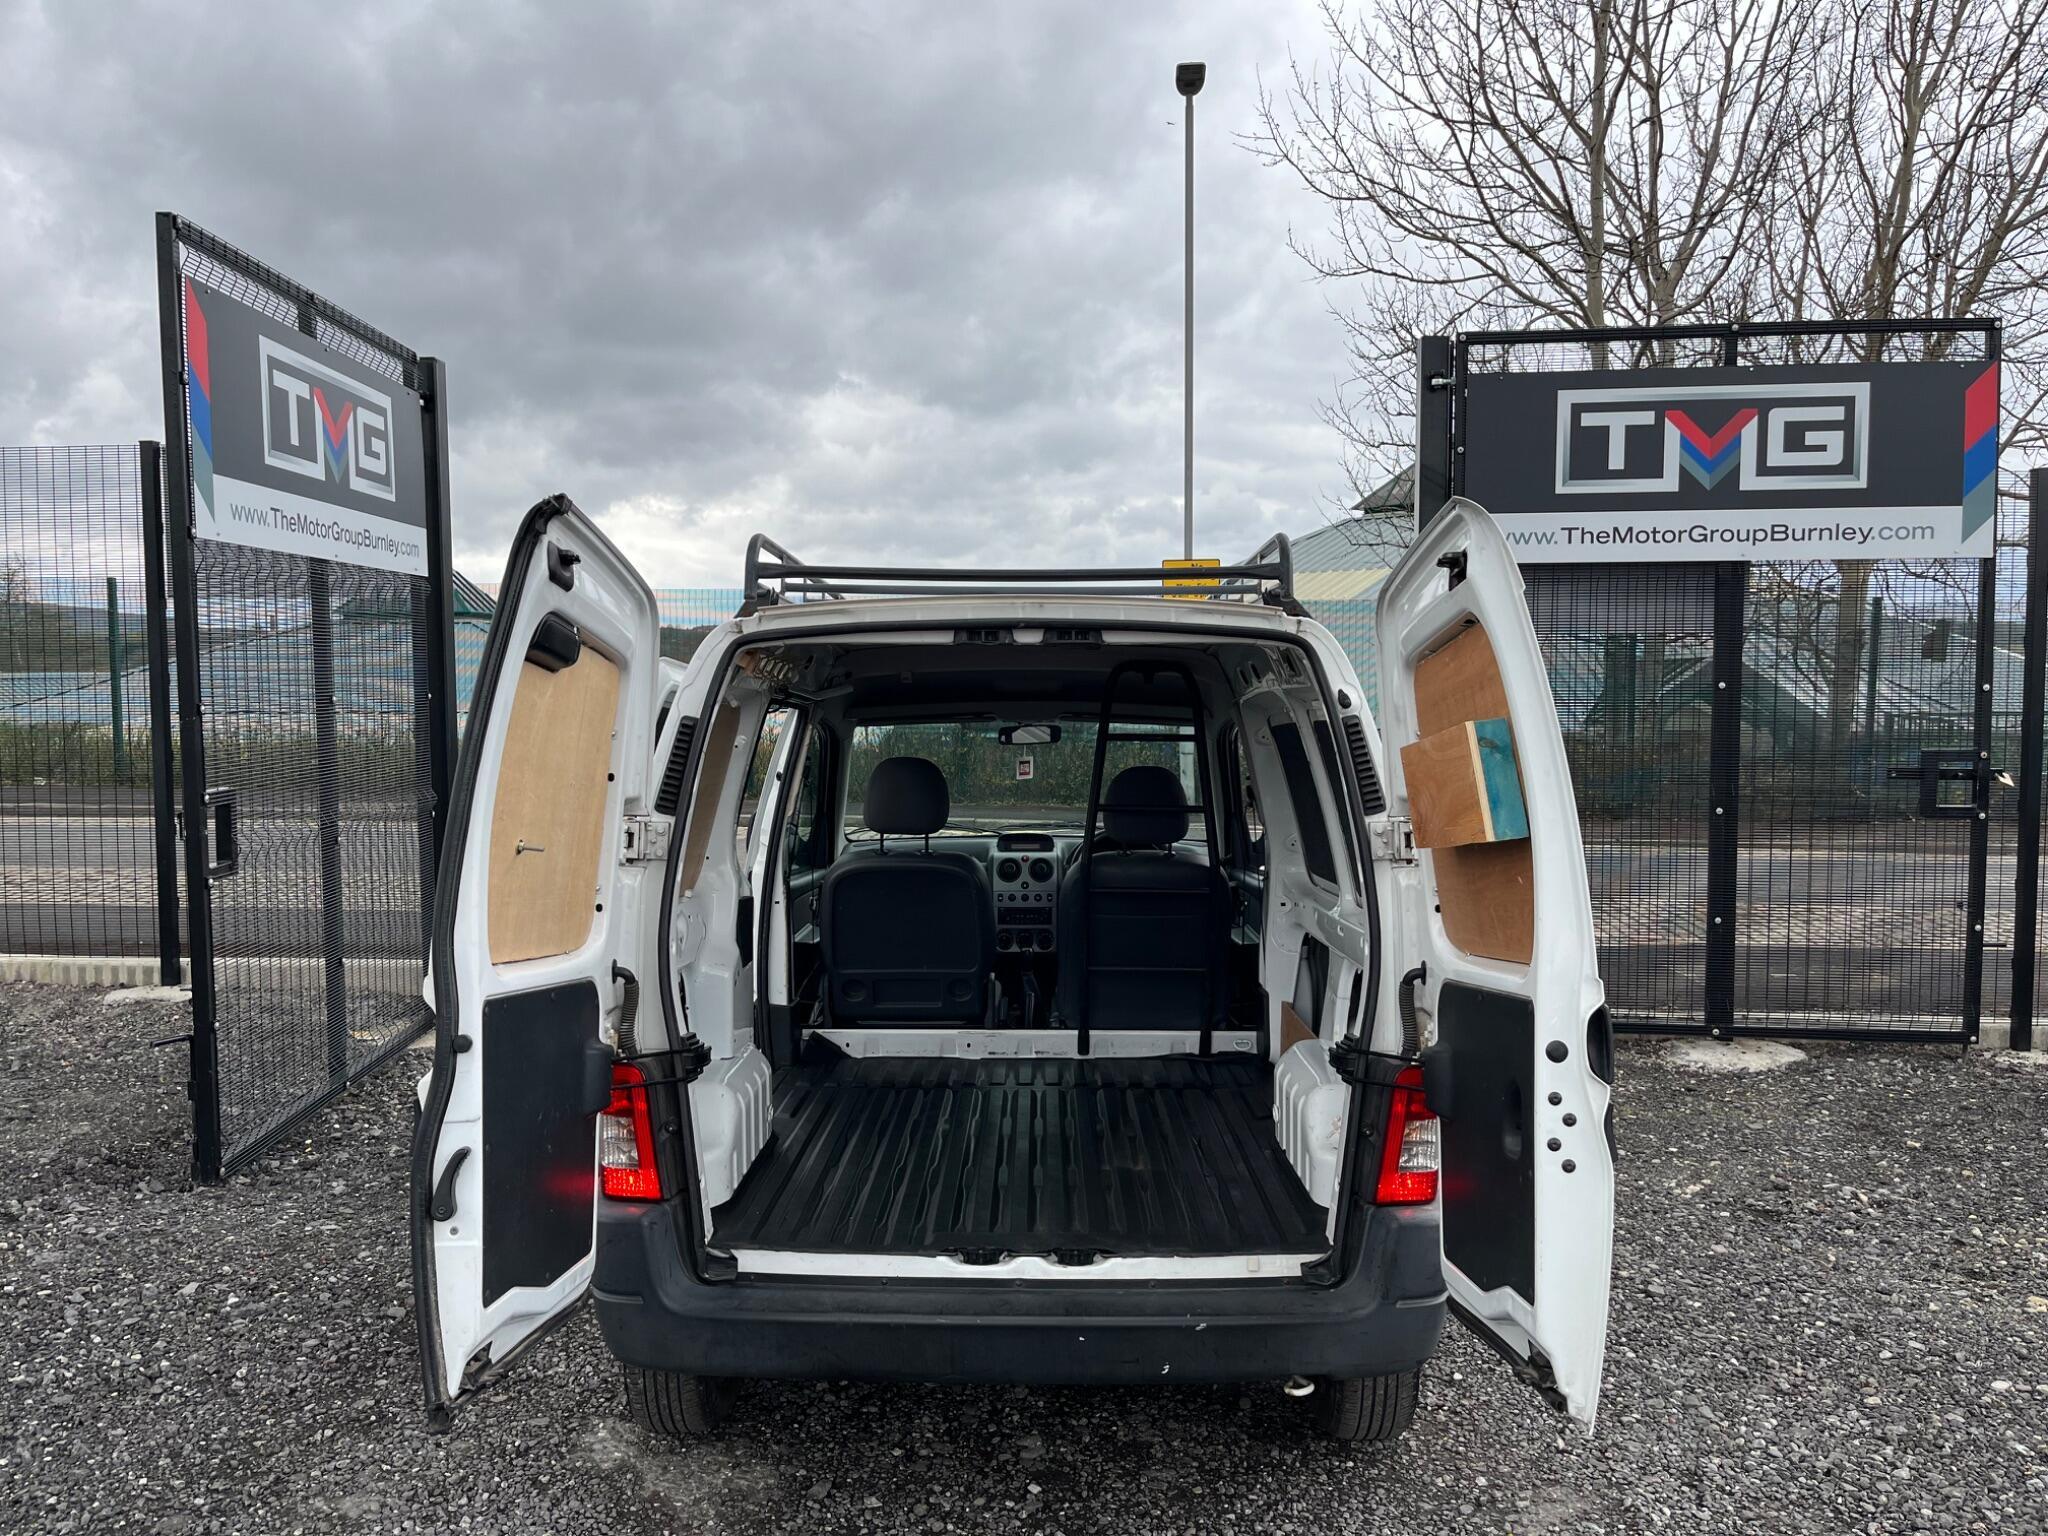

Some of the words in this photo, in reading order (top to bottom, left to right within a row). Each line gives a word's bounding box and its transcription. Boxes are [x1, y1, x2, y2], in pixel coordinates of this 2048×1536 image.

[272, 369, 387, 485] TMG
[1580, 406, 1845, 492] TMG
[230, 503, 420, 557] www.TheMotorGroupBurnley.com
[1506, 523, 1935, 547] ww.TheMotorGroupBurnley.com
